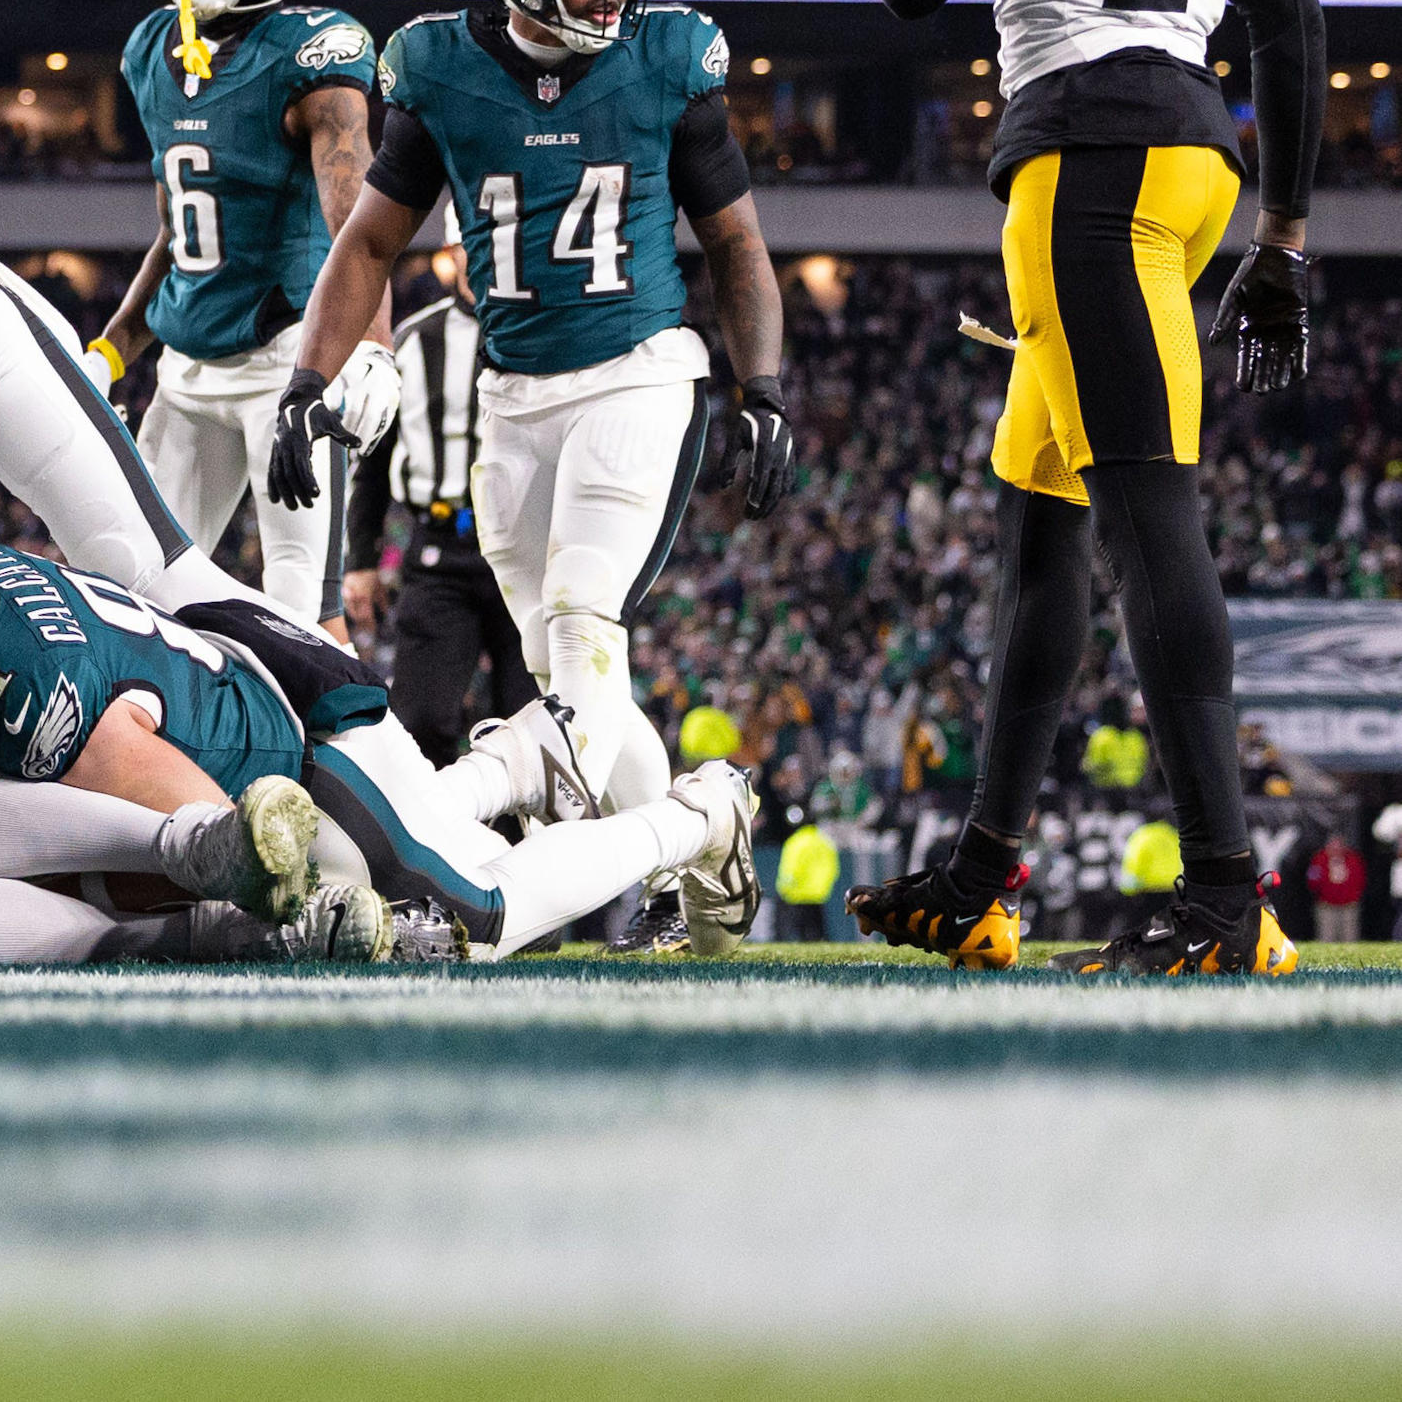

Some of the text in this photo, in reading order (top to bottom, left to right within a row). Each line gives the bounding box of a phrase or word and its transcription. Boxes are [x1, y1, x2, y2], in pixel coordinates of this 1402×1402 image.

[524, 133, 580, 146] EAGLES
[164, 143, 222, 272] 6
[478, 164, 629, 300] 14
